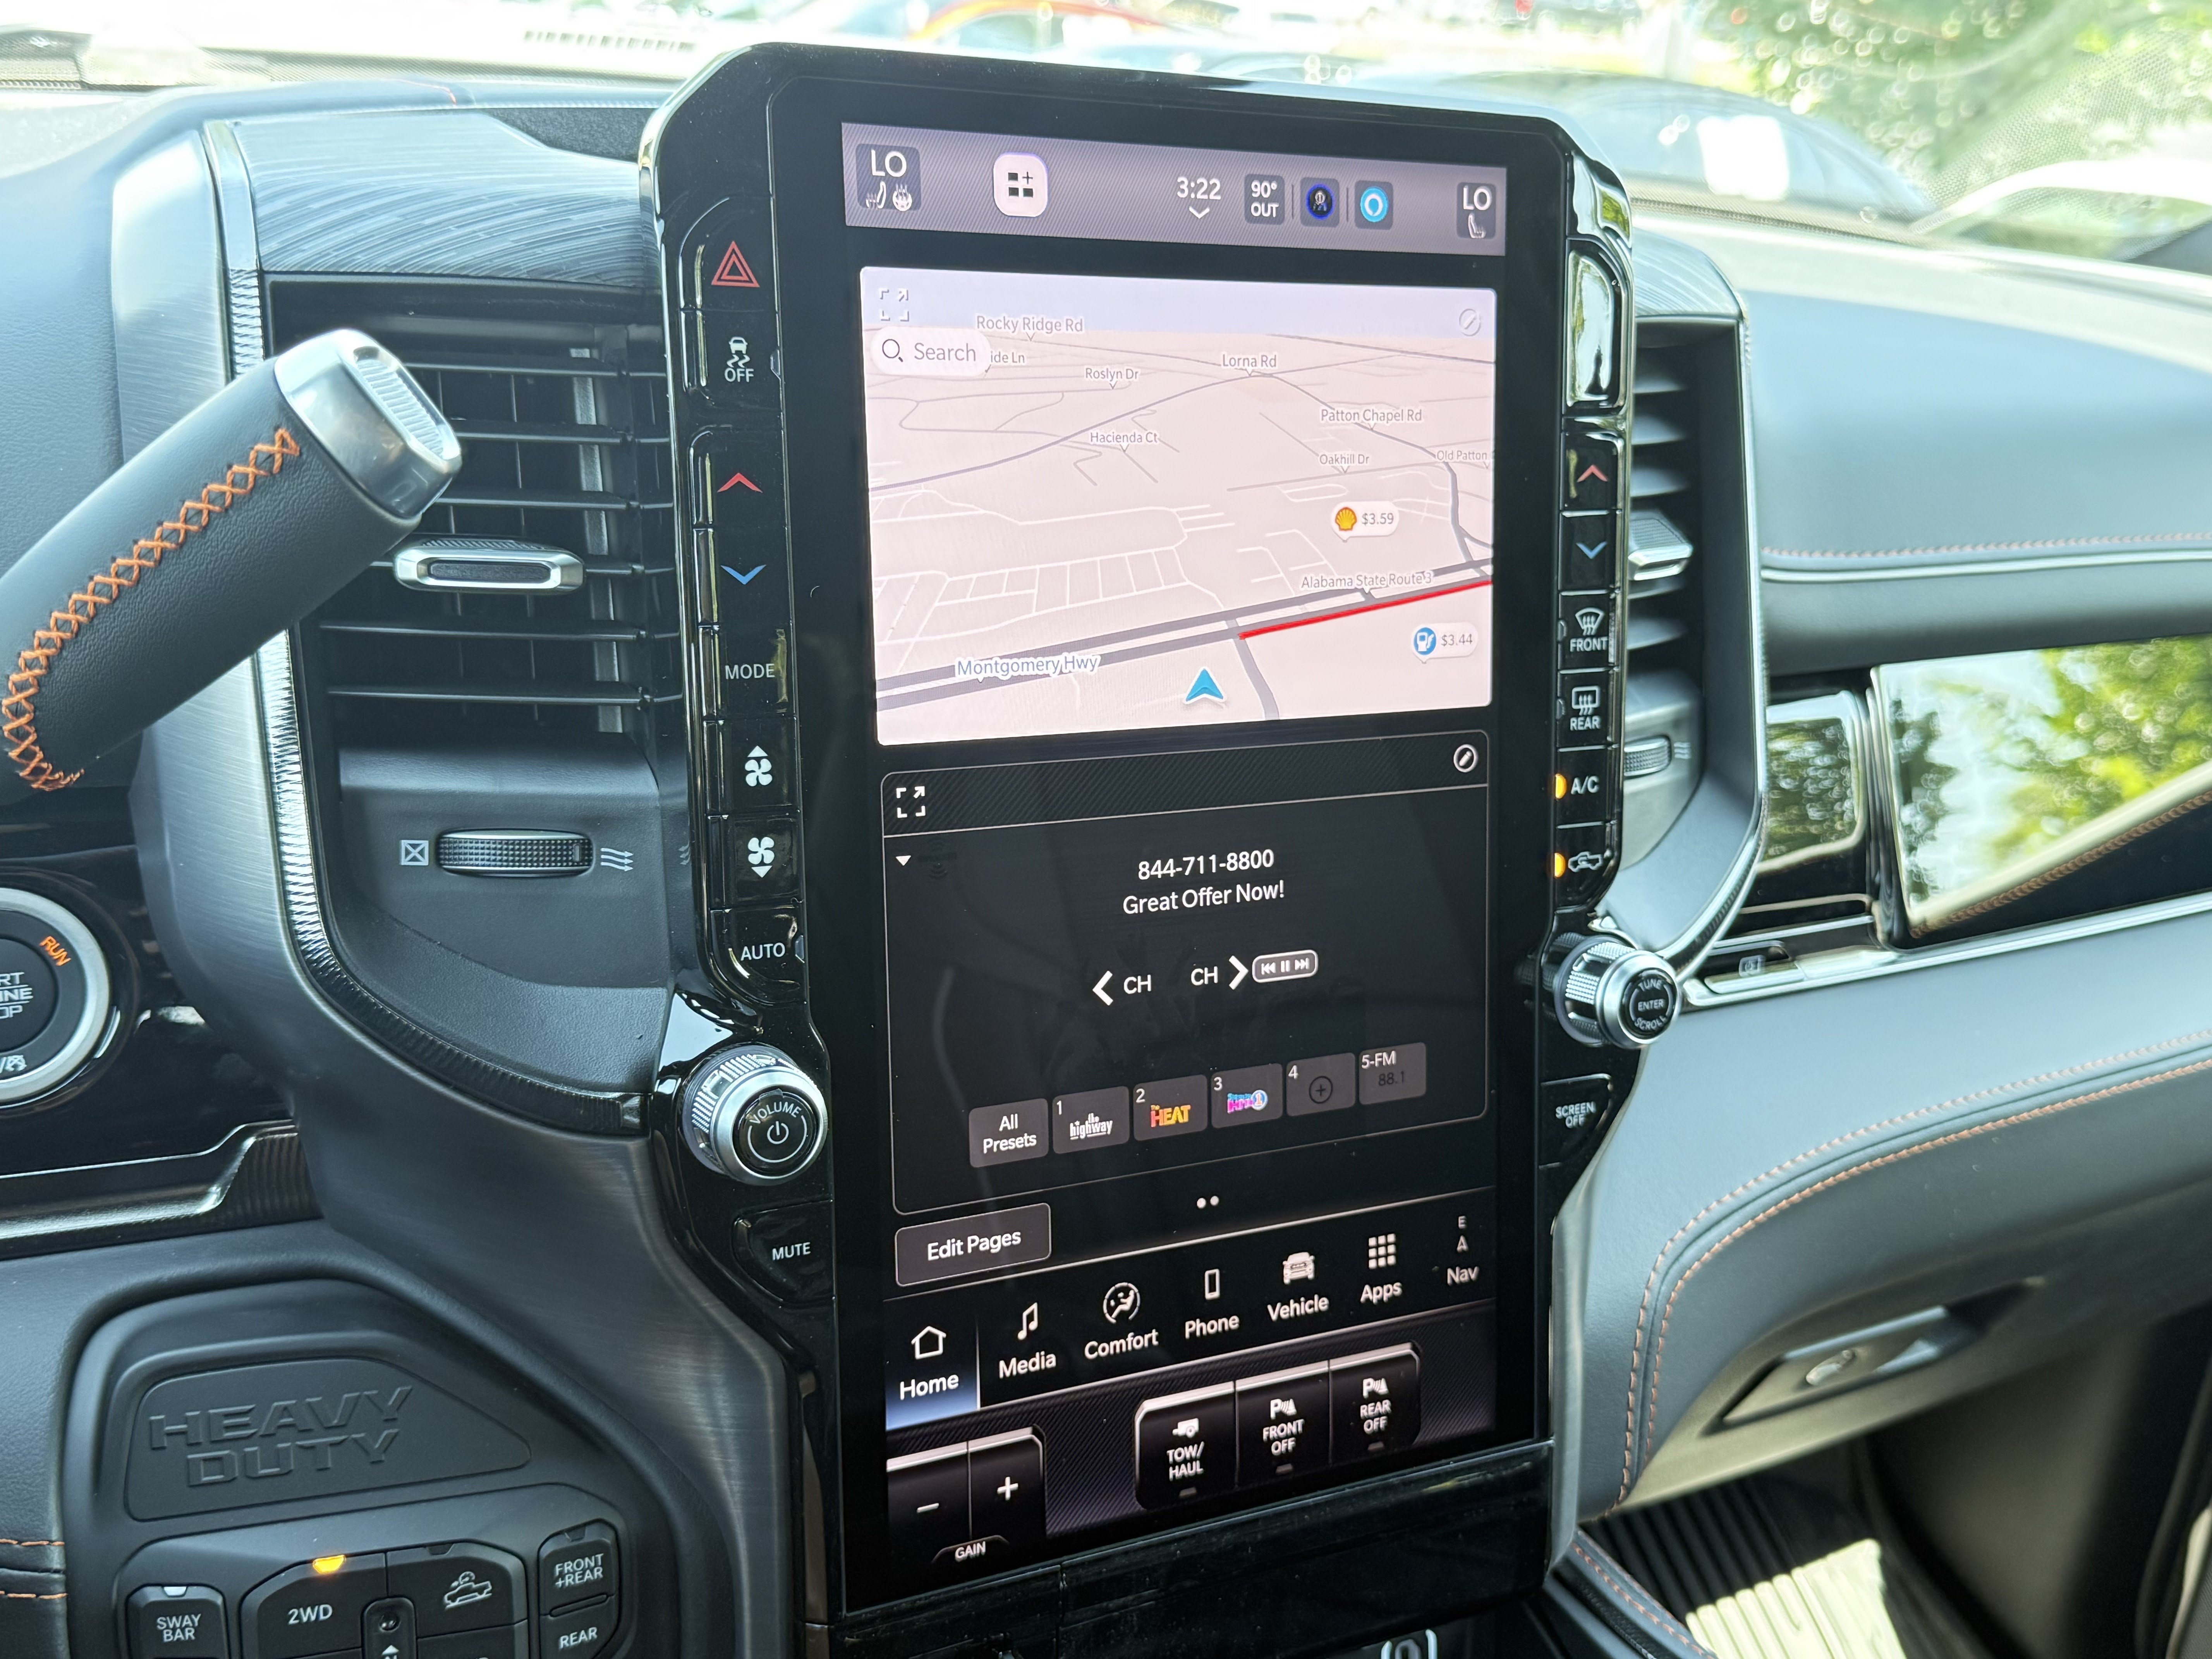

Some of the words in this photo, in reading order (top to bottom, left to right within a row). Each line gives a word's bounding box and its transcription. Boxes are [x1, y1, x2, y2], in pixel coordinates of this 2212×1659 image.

[871, 149, 907, 177] LO
[1176, 176, 1221, 200] 3:22
[1251, 180, 1278, 198] 90°
[1463, 185, 1492, 211] LO
[1251, 202, 1279, 218] OUT
[977, 315, 1018, 333] Rocky
[1023, 317, 1061, 334] Ridge
[1066, 318, 1083, 331] Rd
[914, 343, 976, 362] Search
[1012, 352, 1025, 363] Ln
[1222, 354, 1257, 368] Lorna
[1261, 355, 1277, 368] Rd
[725, 368, 754, 383] OFF
[1085, 368, 1122, 381] Roslyn
[1125, 369, 1139, 380] Dr
[1321, 409, 1360, 422] Patton
[1363, 409, 1404, 424] Chapel
[1407, 409, 1422, 421] Rd
[1090, 432, 1143, 444] Hacienda
[1146, 432, 1158, 443] Ct
[1319, 453, 1355, 465] Oakhill
[1358, 454, 1369, 465] Dr
[1437, 450, 1453, 460] Old
[1457, 450, 1487, 460] Patton
[1362, 513, 1394, 526] $3.59
[1301, 575, 1353, 588] Alabama
[1356, 574, 1386, 587] State
[1389, 573, 1422, 585] Route
[1425, 572, 1431, 584] 3
[1441, 634, 1473, 647] $3.44
[1570, 636, 1608, 652] FRONT
[725, 663, 775, 680] MODE
[957, 658, 1062, 676] Montgomery
[1064, 656, 1099, 674] Hwy
[1570, 716, 1601, 731] REAR
[1571, 775, 1599, 795] A/C
[1138, 849, 1274, 880] 844-711-8800
[1123, 892, 1178, 914] Great
[1182, 887, 1232, 908] Offer
[1236, 880, 1285, 903] Now!
[40, 936, 71, 966] RUN
[740, 942, 786, 962] AUTO
[1124, 975, 1151, 994] CH
[1191, 966, 1218, 986] CH
[1638, 979, 1662, 991] TUNE
[1638, 999, 1665, 1012] ENTER
[1635, 1016, 1668, 1030] SCROLL
[1361, 1050, 1397, 1069] 5-FM
[1288, 1065, 1298, 1080] 4
[1378, 1070, 1405, 1087] 88.1
[1214, 1077, 1223, 1091] 3
[1136, 1089, 1146, 1103] 2
[749, 1101, 802, 1125] VOLUME
[1056, 1101, 1063, 1115] 1
[1151, 1105, 1191, 1127] HEAT
[1555, 1101, 1596, 1119] SCREEN
[999, 1114, 1018, 1132] All
[1070, 1120, 1113, 1139] highway
[1565, 1113, 1585, 1128] OFF
[983, 1133, 1037, 1154] Presets
[1458, 1216, 1467, 1229] E
[772, 1242, 811, 1261] MUTE
[927, 1241, 963, 1261] Edit
[967, 1231, 1021, 1254] Pages
[1447, 1265, 1479, 1286] Nav
[1361, 1281, 1402, 1305] Apps
[1267, 1294, 1329, 1321] Vehicle
[1185, 1314, 1240, 1340] Phone
[1084, 1328, 1159, 1360] Comfort
[999, 1351, 1057, 1379] Media
[900, 1373, 959, 1401] Home
[150, 1385, 413, 1449] HEAVY
[1360, 1399, 1392, 1419] REAR
[1263, 1419, 1305, 1443] FRONT
[1364, 1415, 1388, 1434] OFF
[1167, 1441, 1205, 1464] TOW/
[1271, 1437, 1296, 1456] OFF
[187, 1429, 400, 1487] DUTY
[1169, 1460, 1204, 1481] HAUL
[955, 1541, 986, 1563] GAIN
[555, 1553, 604, 1577] FRONT
[555, 1567, 603, 1588] +REAR
[156, 1613, 201, 1630] SWAY
[287, 1604, 333, 1625] 2WD
[163, 1628, 195, 1643] BAR
[559, 1627, 598, 1651] REAR
